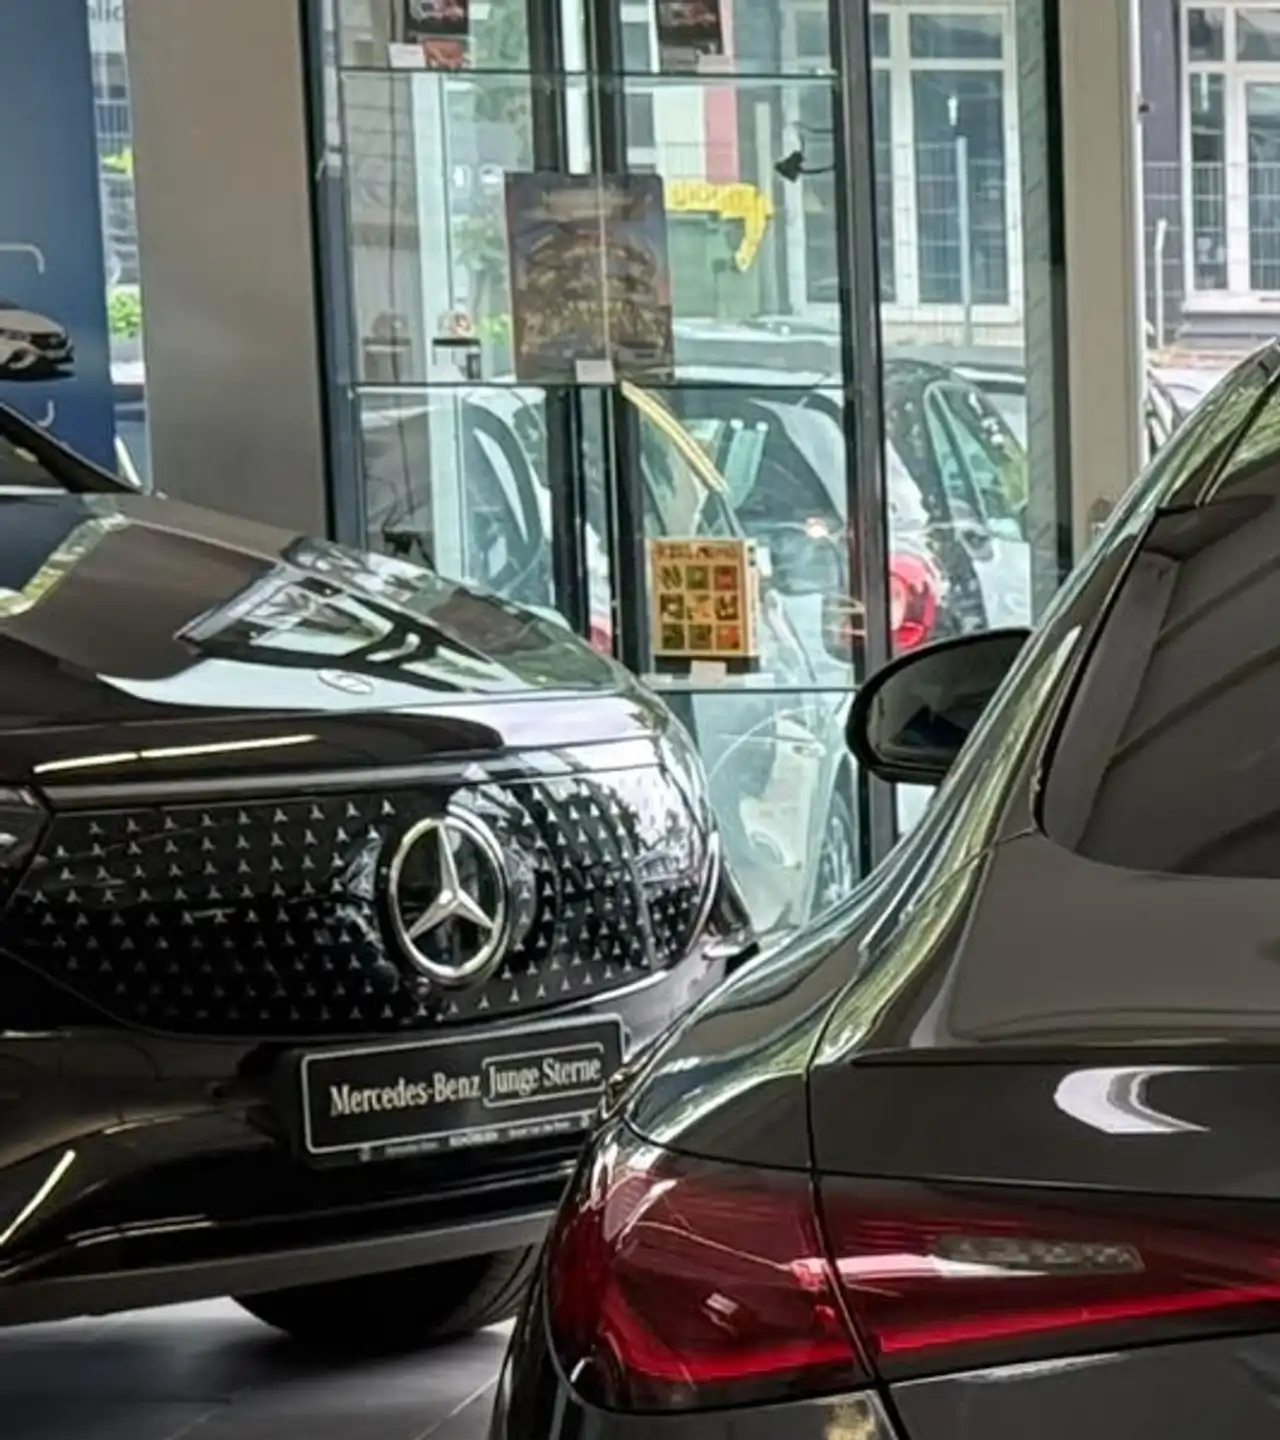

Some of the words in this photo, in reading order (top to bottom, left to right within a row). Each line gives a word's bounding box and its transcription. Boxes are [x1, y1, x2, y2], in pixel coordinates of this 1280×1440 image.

[329, 1071, 482, 1118] Mercedes-Benz
[488, 1065, 540, 1097] Junge
[542, 1057, 602, 1087] Sterne
